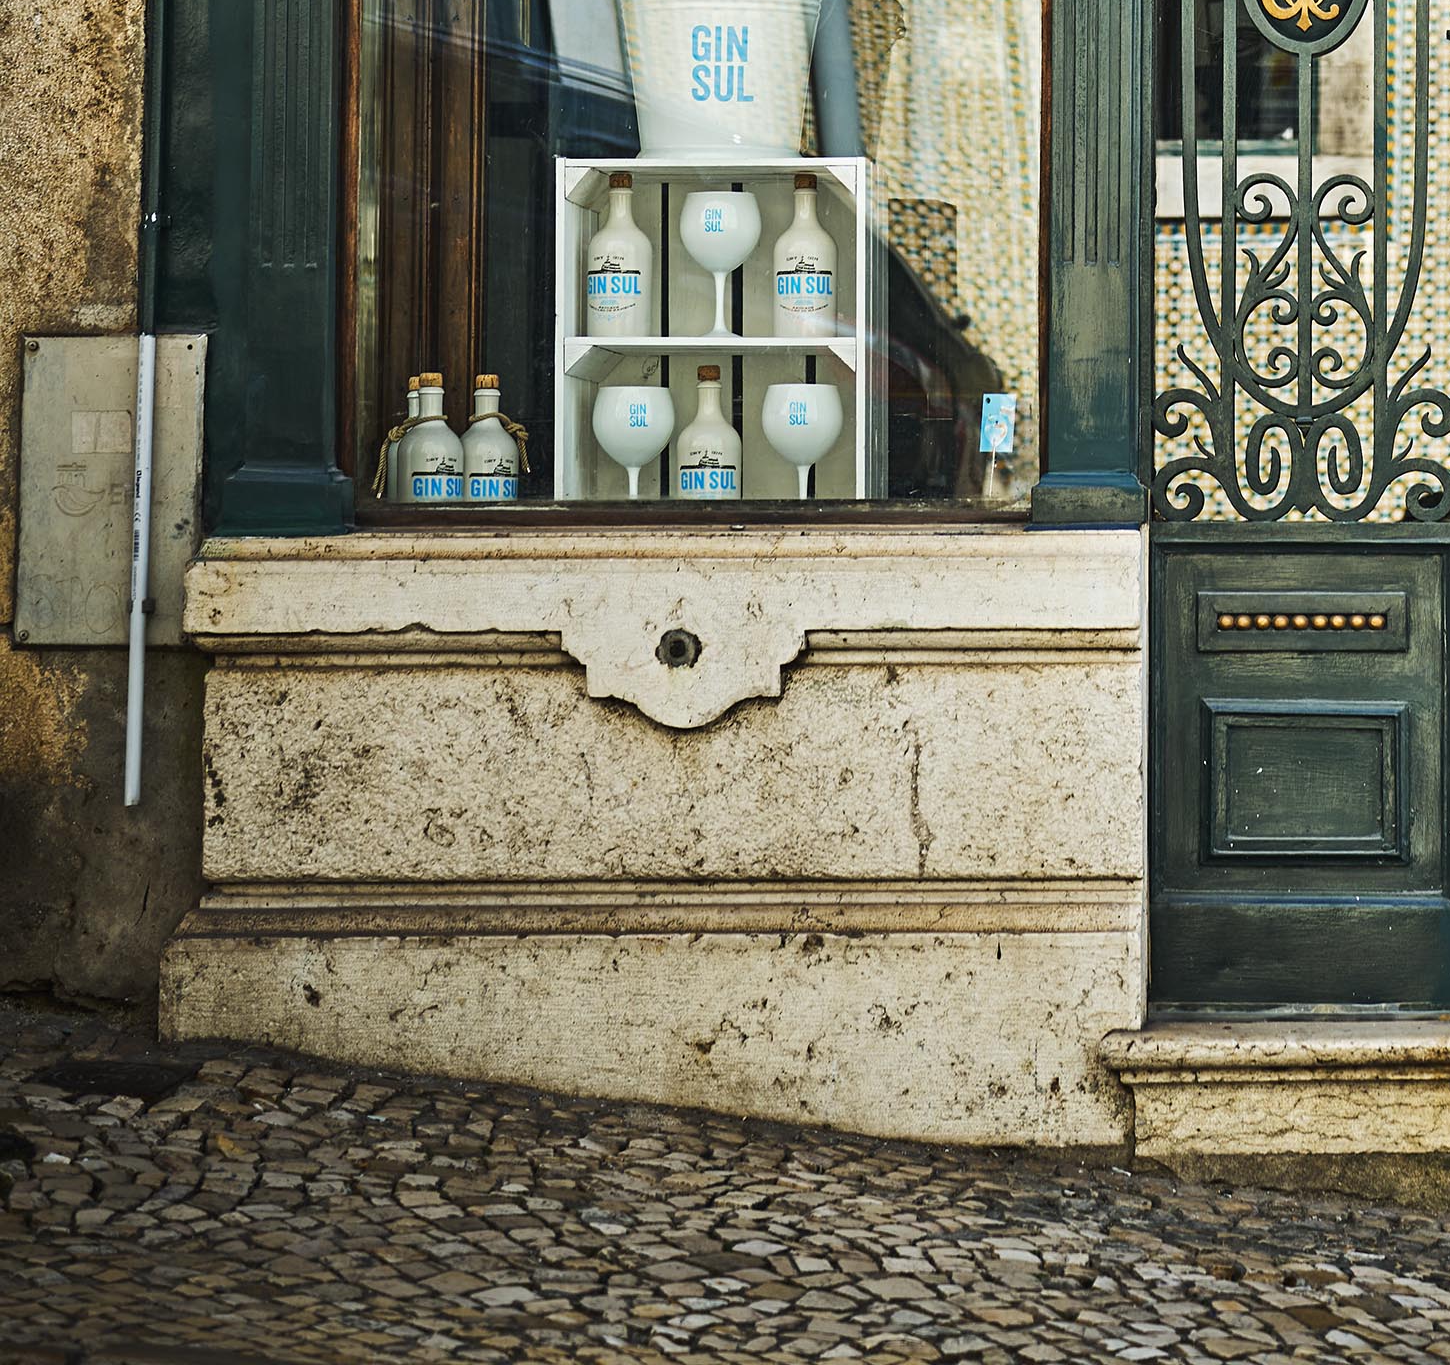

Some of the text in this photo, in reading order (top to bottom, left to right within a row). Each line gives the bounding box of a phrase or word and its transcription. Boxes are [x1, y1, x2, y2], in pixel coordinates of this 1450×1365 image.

[691, 24, 749, 63] GIN
[691, 64, 754, 102] SUL
[704, 208, 722, 220] GIN
[704, 220, 724, 232] SUL
[587, 275, 641, 294] GIN SUL
[777, 276, 833, 295] GIN SUL
[629, 403, 647, 415] GIN
[629, 415, 649, 428] SUL
[789, 413, 808, 426] SUL
[413, 477, 463, 498] GIN SU
[470, 478, 518, 498] GIN SU
[681, 470, 737, 490] GIN SUL
